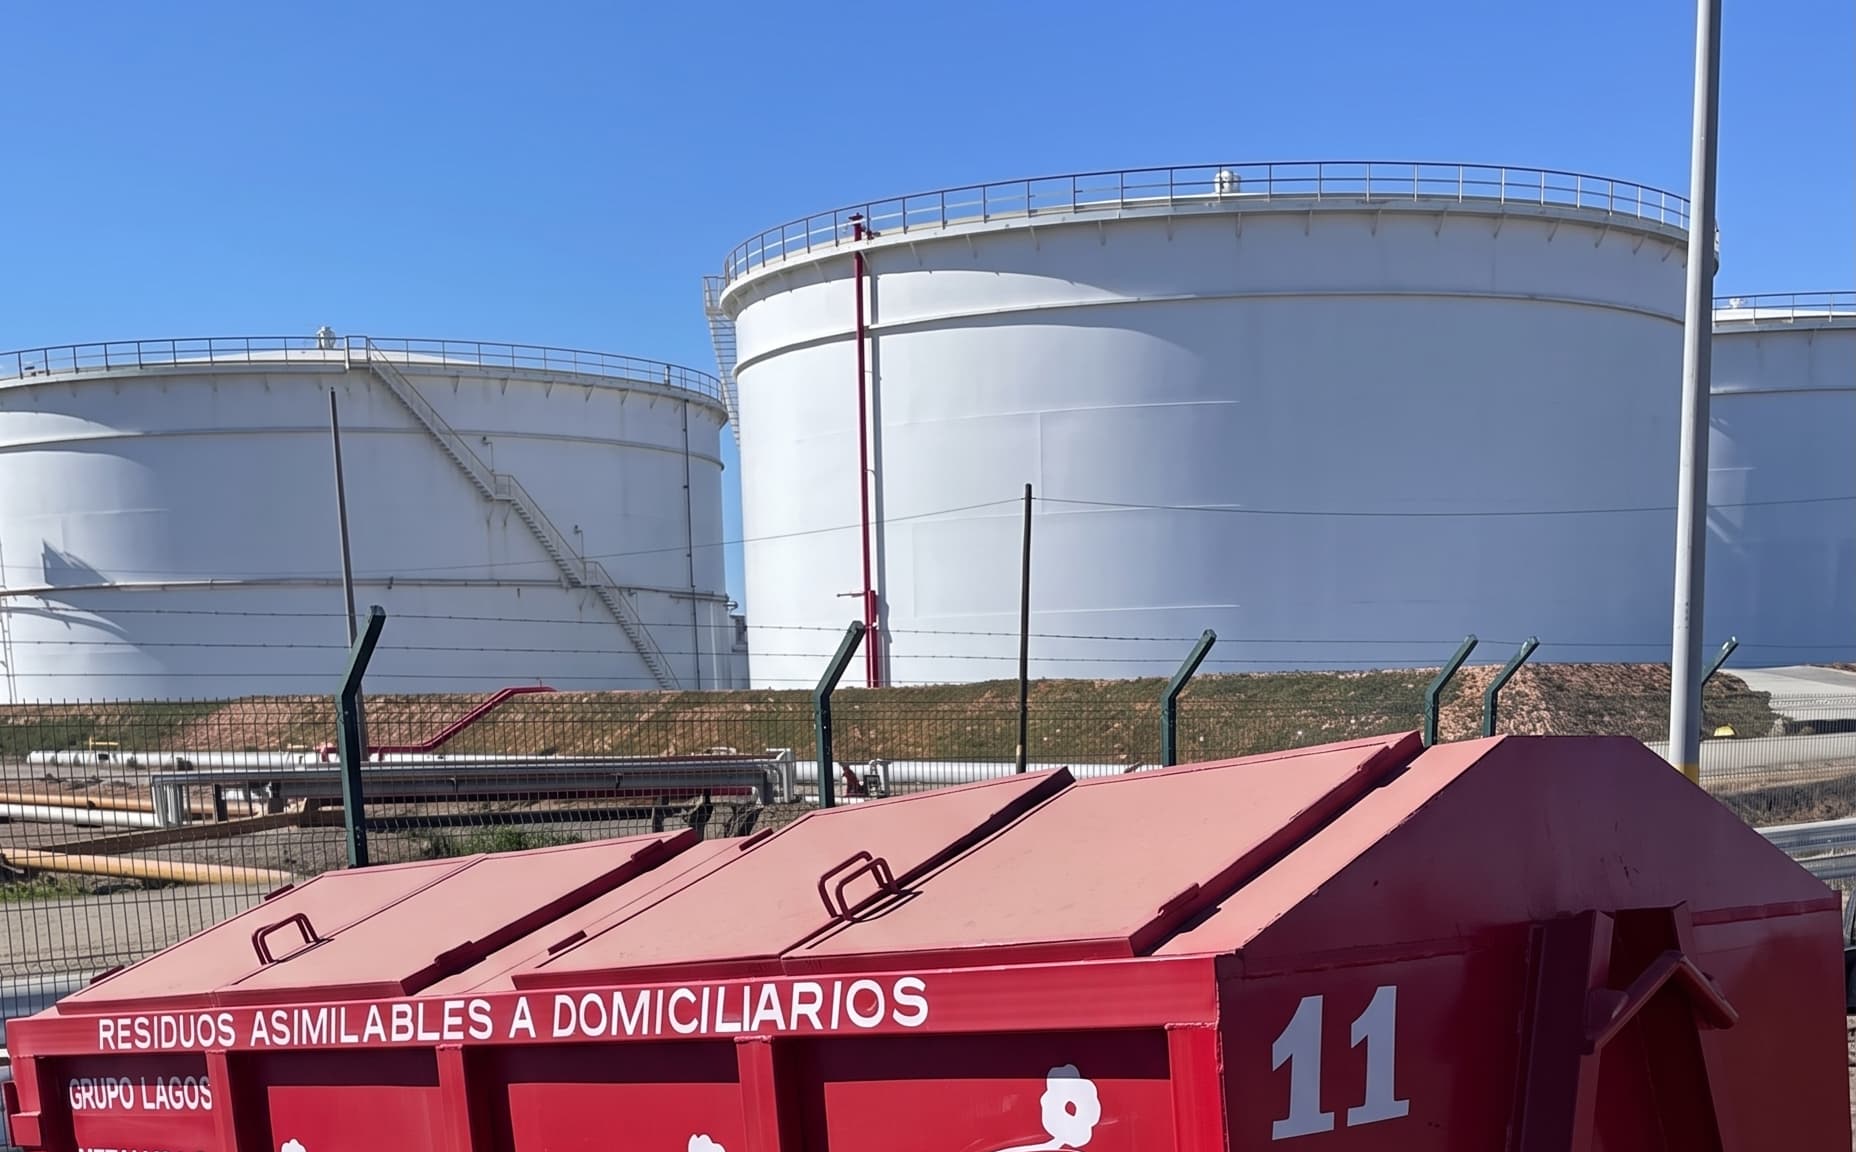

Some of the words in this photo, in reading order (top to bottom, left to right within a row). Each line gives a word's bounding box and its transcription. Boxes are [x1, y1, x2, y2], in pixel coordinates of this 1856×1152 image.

[98, 1012, 236, 1051] RESIDUOS
[250, 999, 493, 1046] ASIMILABLES
[508, 996, 536, 1038] A
[552, 976, 929, 1037] DOMICILIARIOS
[69, 1077, 135, 1110] GRUPO
[140, 1075, 213, 1111] LAGOS
[1271, 985, 1410, 1141] 11
